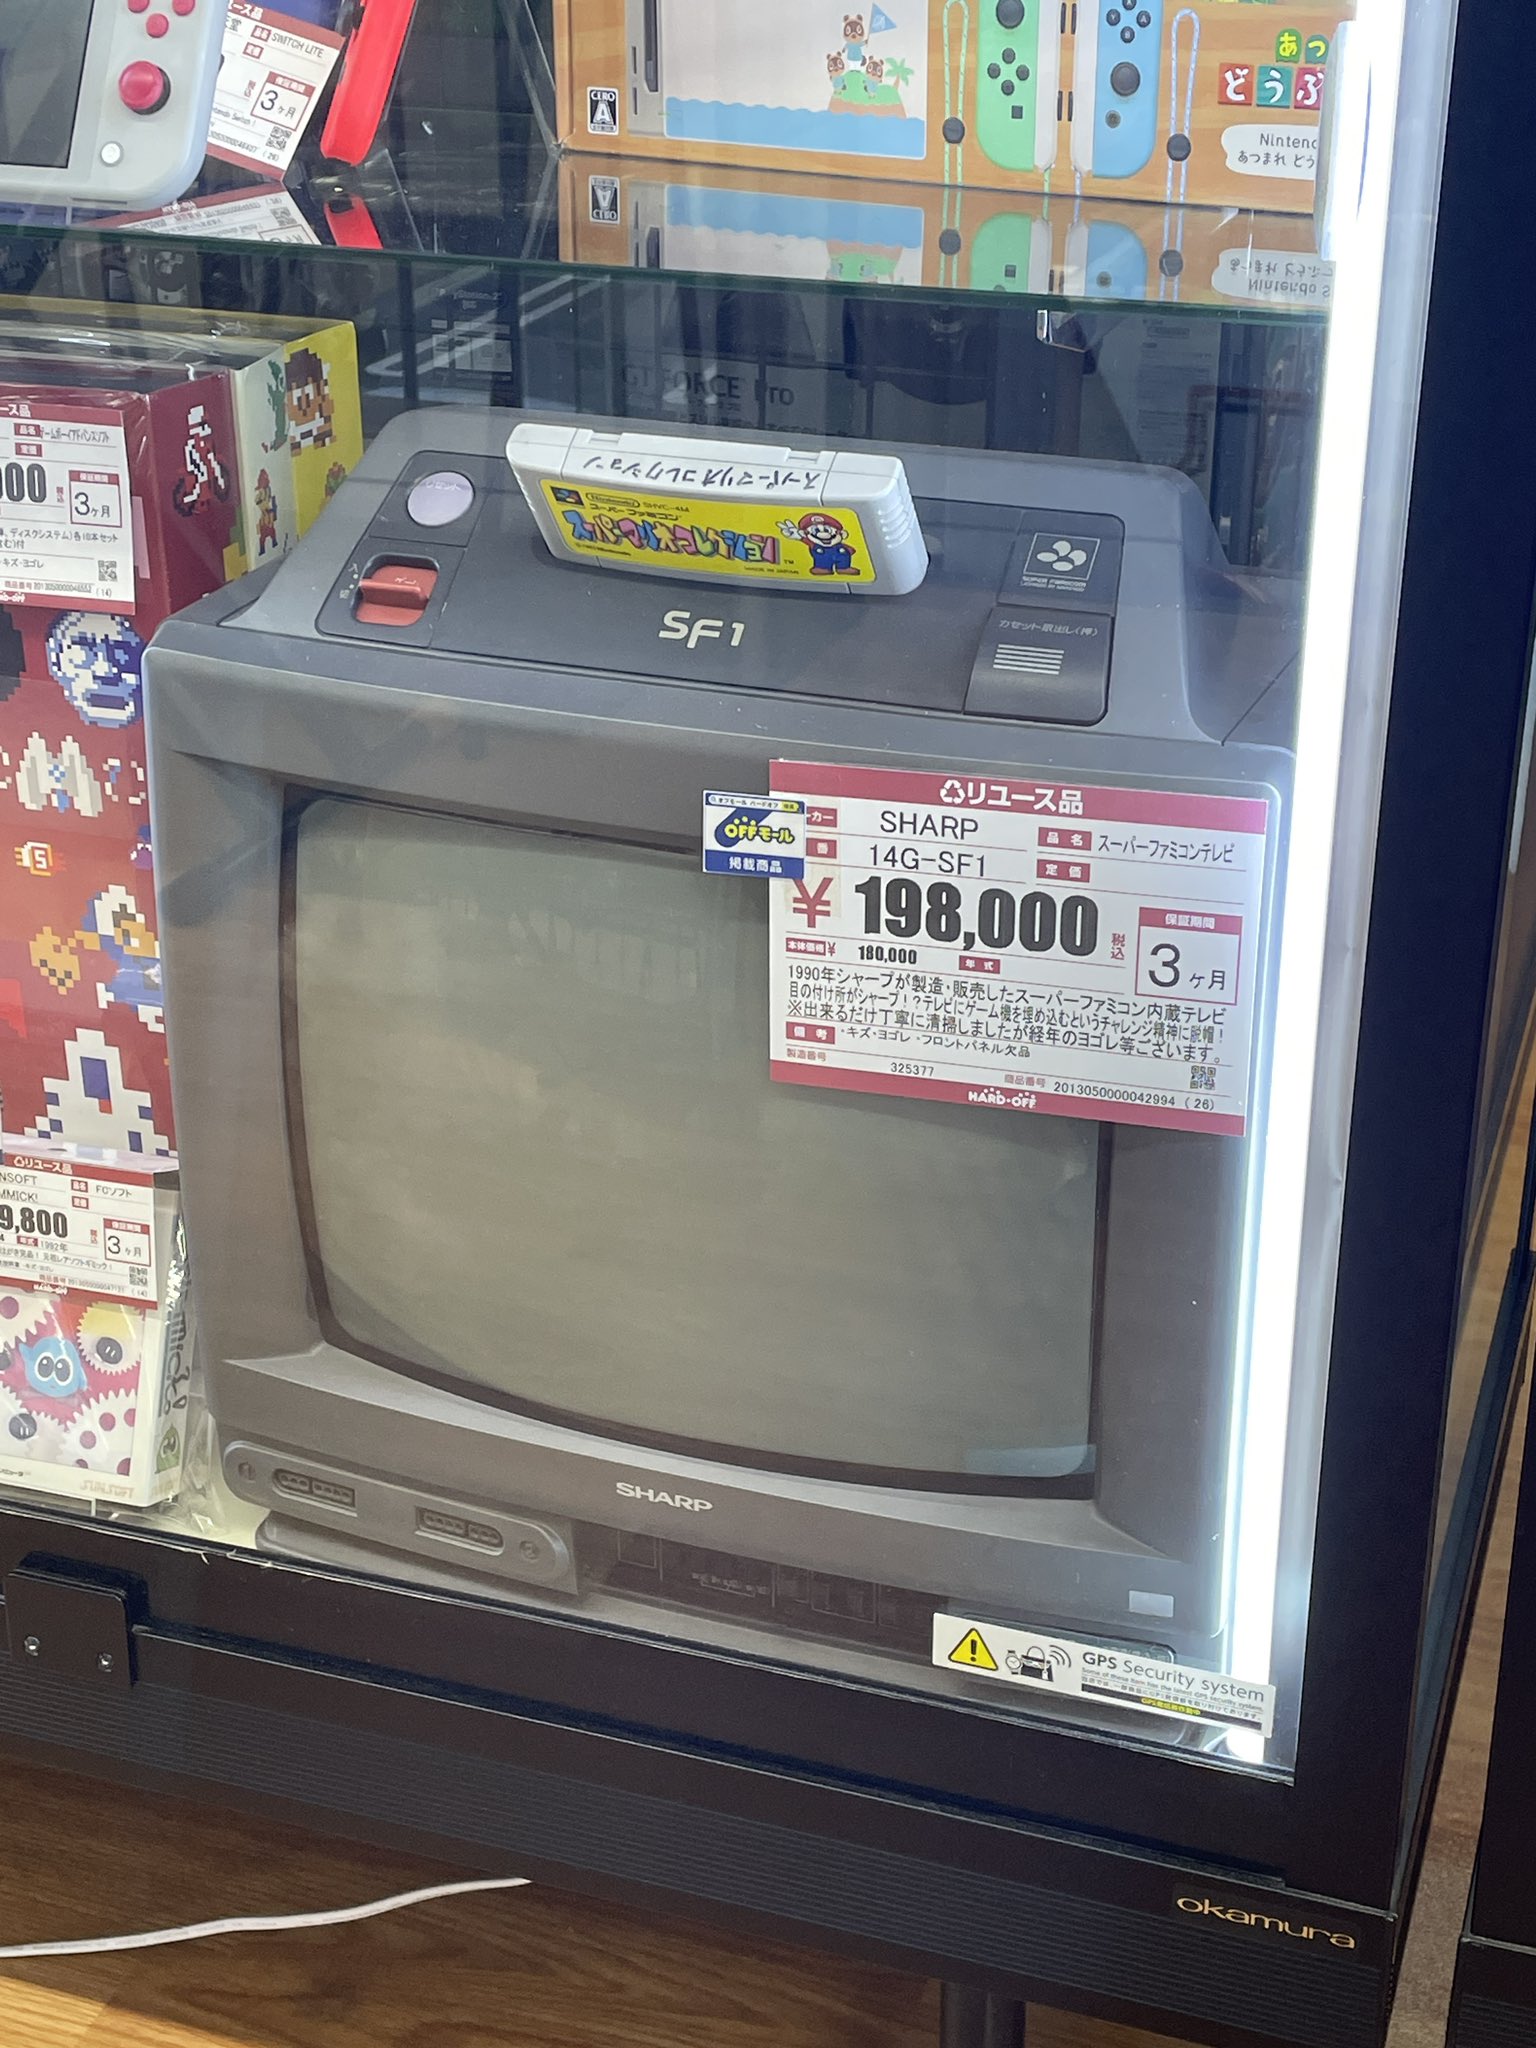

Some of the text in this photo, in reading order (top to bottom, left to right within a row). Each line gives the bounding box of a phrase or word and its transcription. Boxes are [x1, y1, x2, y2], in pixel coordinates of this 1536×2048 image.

[271, 32, 325, 58] SWITCH LITE
[658, 610, 745, 650] SF1
[967, 781, 1084, 816] リユース品
[880, 810, 979, 840] SHARP
[1046, 831, 1084, 847] 品名
[870, 844, 985, 877] 14G-SF1
[1098, 834, 1236, 864] スーパーファミコンテレビ
[728, 856, 783, 874] 掲載商品
[855, 876, 1098, 957] 198,000
[858, 945, 918, 965] 180,000
[964, 957, 994, 972] 年式
[890, 1062, 935, 1077] 325377
[616, 1481, 713, 1512] SHARP
[1082, 1651, 1264, 1703] GPS Security system
[1177, 1897, 1356, 1950] okamura
